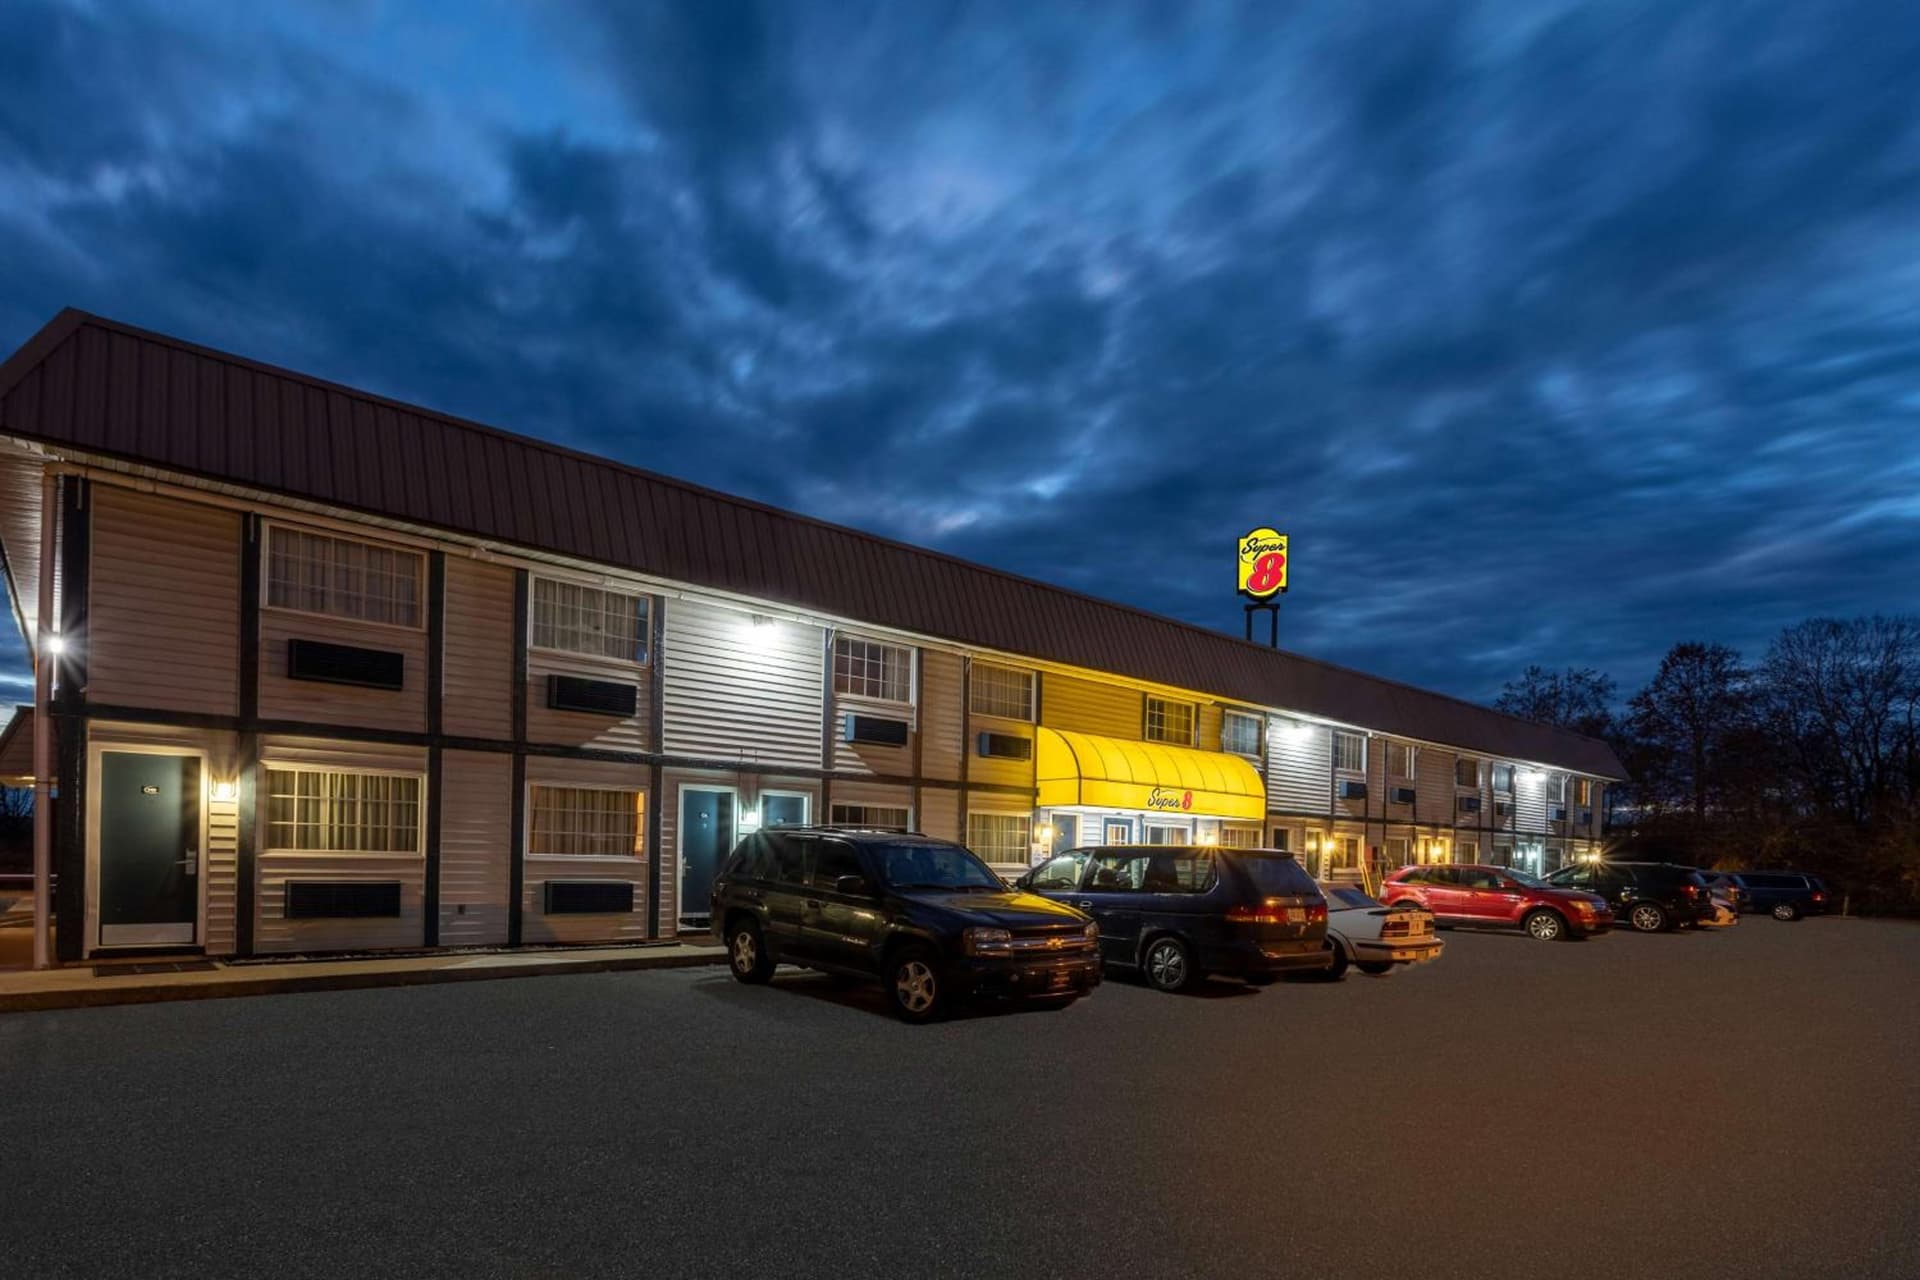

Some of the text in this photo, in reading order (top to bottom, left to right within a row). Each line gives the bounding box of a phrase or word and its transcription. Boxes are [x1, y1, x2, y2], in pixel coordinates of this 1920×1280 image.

[1241, 537, 1285, 561] Super
[1247, 552, 1285, 593] 8
[1147, 787, 1193, 811] Super 8
